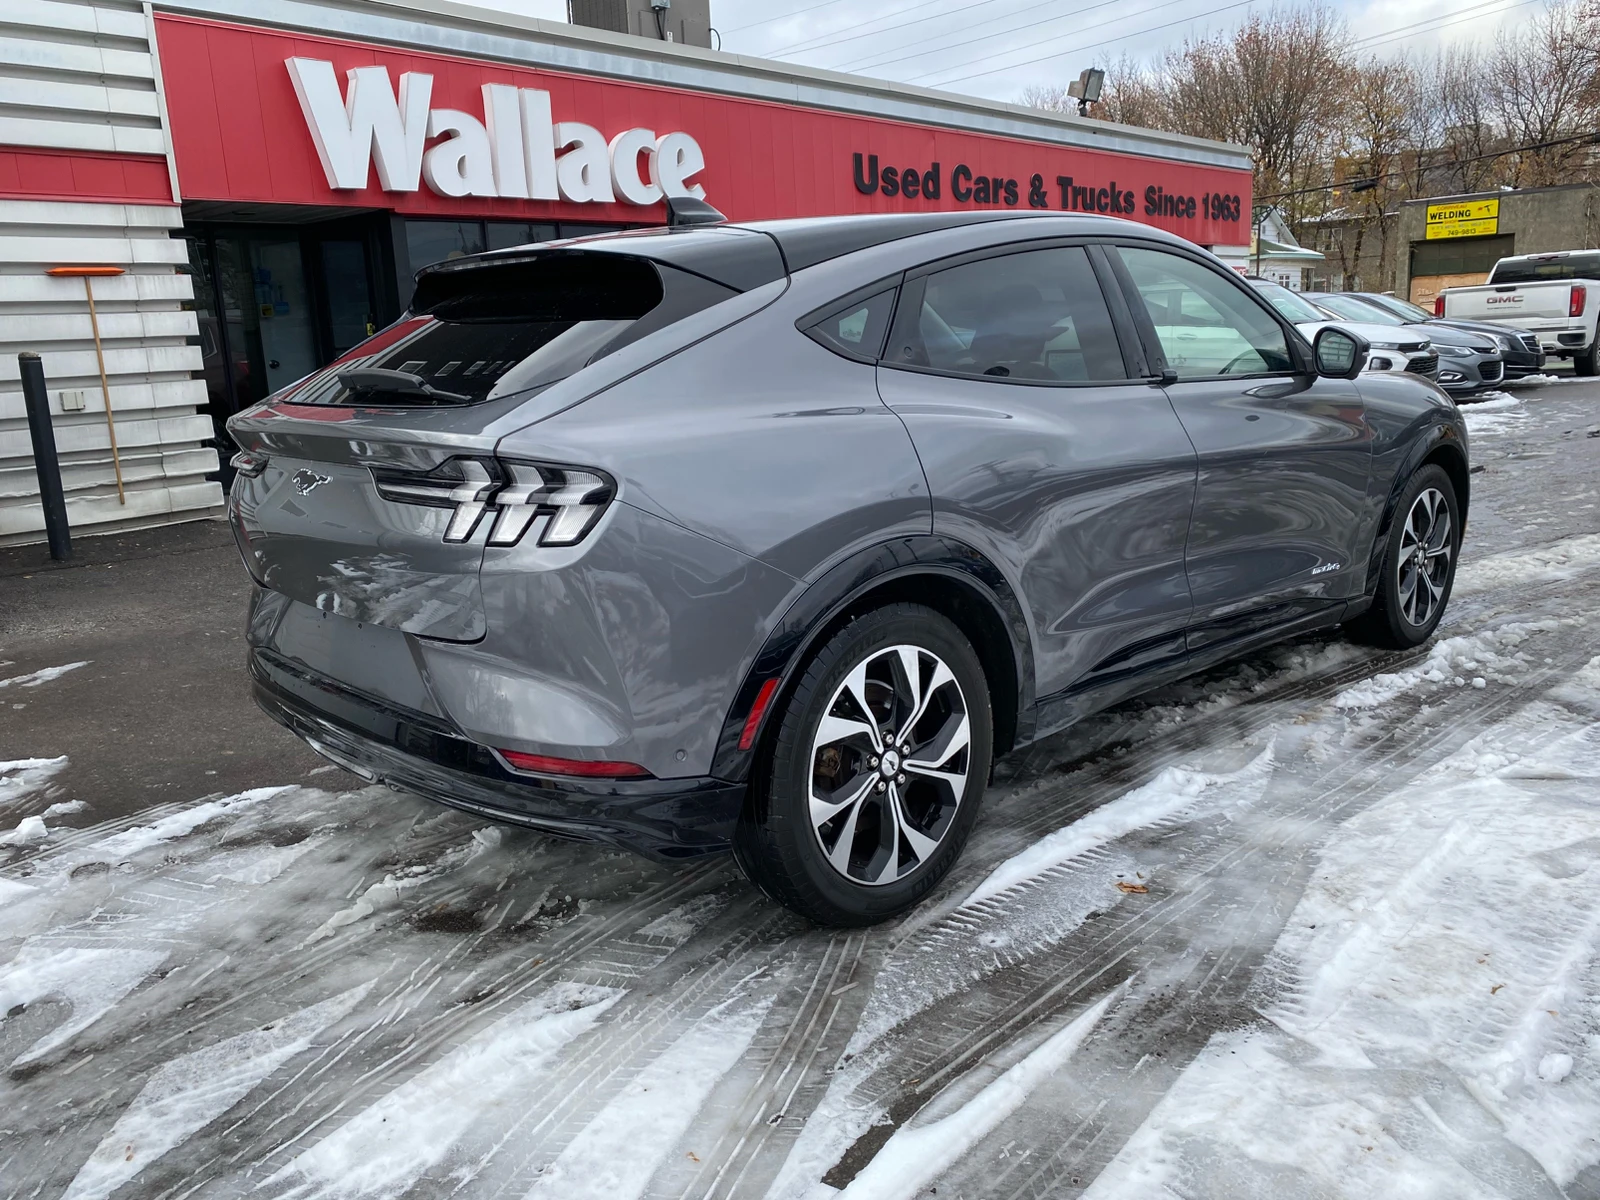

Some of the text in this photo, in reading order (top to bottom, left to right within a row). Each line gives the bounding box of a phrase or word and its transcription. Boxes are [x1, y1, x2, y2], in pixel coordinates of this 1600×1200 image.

[284, 56, 706, 206] Wallace
[853, 152, 1241, 222] Used Cars & Trucks Since 1963
[1430, 209, 1471, 220] WELDING
[1447, 228, 1476, 236] 749-9813
[1486, 295, 1524, 304] GMC
